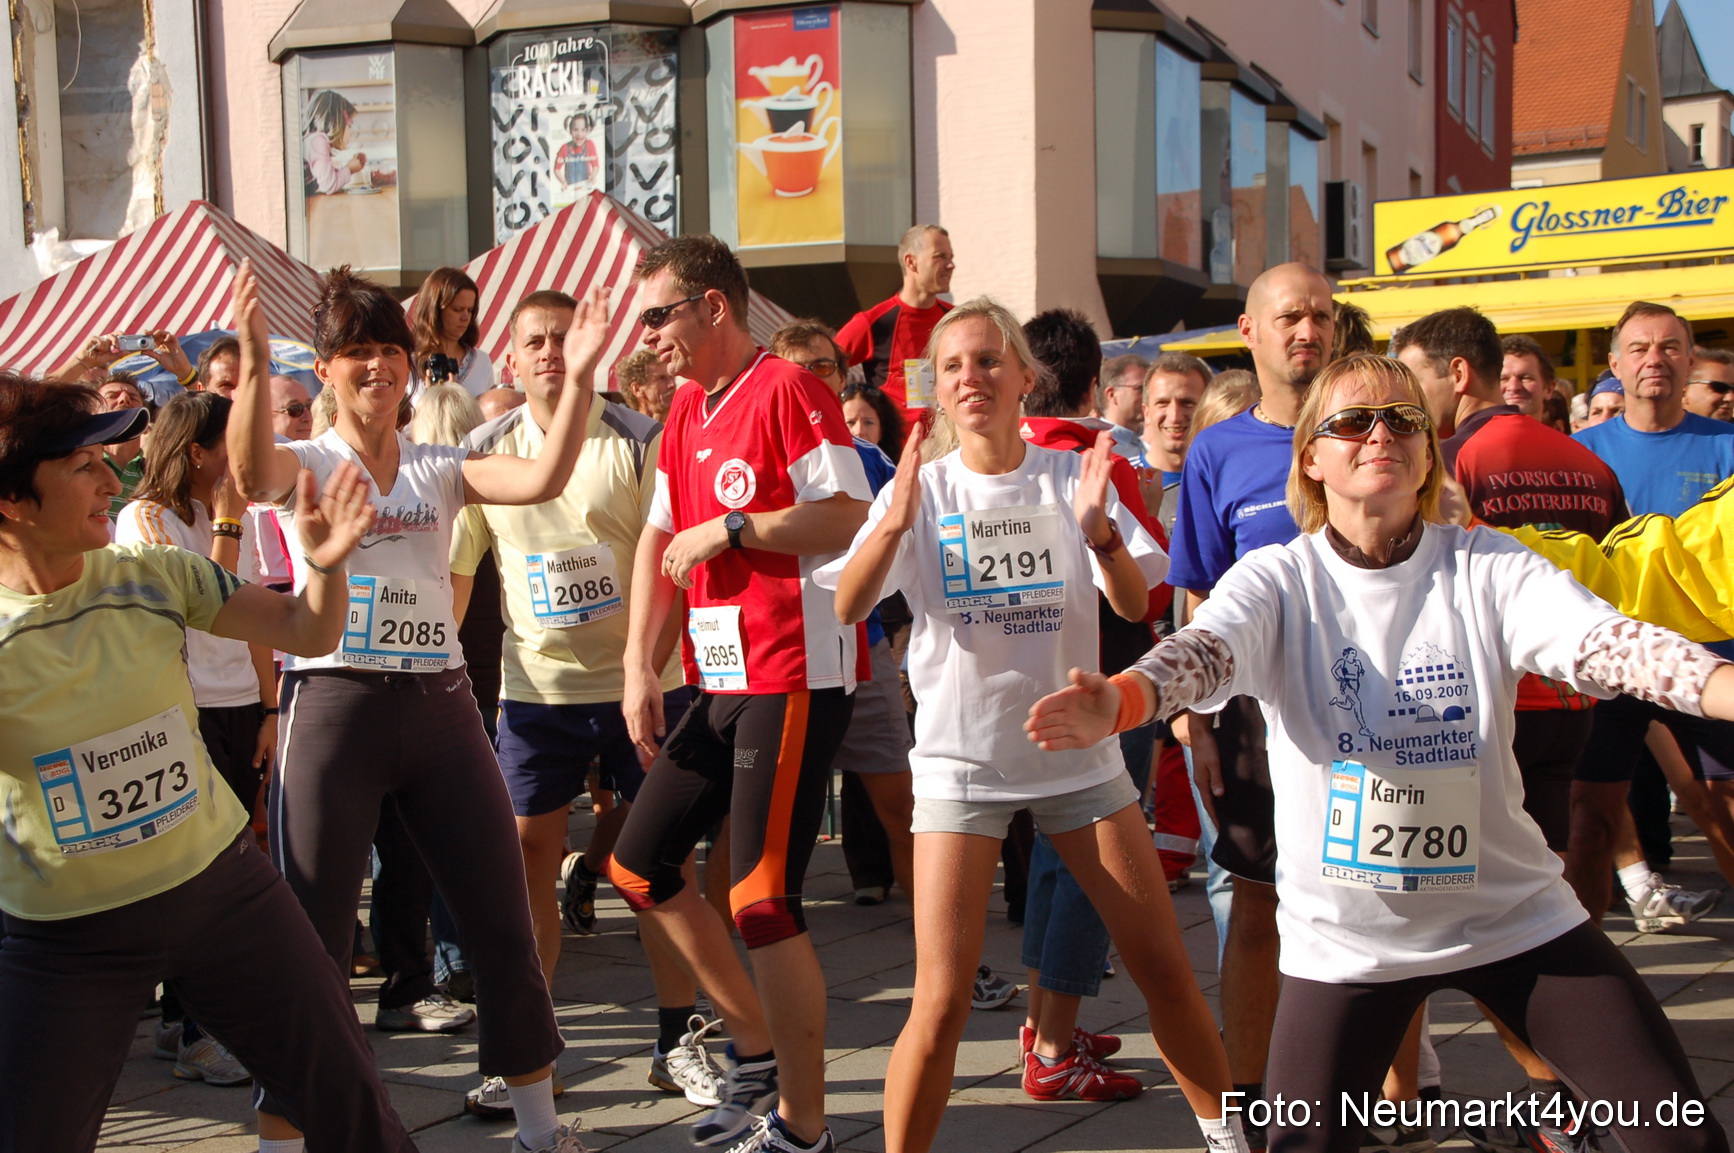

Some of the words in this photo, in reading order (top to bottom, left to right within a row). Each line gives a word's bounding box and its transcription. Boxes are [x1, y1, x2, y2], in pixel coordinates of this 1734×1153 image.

[523, 43, 548, 63] 100
[551, 36, 594, 59] Jahre
[517, 60, 584, 99] RACKL
[1509, 186, 1729, 254] Glossner-Bier
[1480, 492, 1608, 517] KLOSTERBIKER
[971, 518, 1032, 539] Martina
[546, 555, 598, 574] Matthias
[945, 552, 954, 567] C
[978, 548, 1053, 583] 2191
[379, 585, 418, 605] Anita
[554, 575, 614, 607] 2086
[1021, 587, 1064, 600] PFLEIDERER
[946, 595, 993, 609] BOCK
[350, 610, 359, 624] D
[984, 606, 1064, 624] Neumarkter
[378, 619, 447, 648] 2085
[342, 653, 388, 666] BOCK
[412, 658, 448, 667] PFLEIDERER
[703, 644, 739, 667] 2695
[1394, 684, 1469, 704] 16.09.2007
[80, 730, 169, 774] Veronika
[1337, 731, 1363, 754] 8.
[1369, 729, 1474, 752] Neumarkter
[1395, 743, 1477, 766] Stadtlauf
[97, 760, 190, 821] 3273
[1370, 778, 1425, 805] Karin
[53, 796, 66, 813] D
[155, 795, 199, 828] PFLEIDERER
[1332, 808, 1342, 826] D
[61, 833, 122, 853] BOCK
[1369, 823, 1468, 860] 2780
[1322, 865, 1382, 885] BOCK
[1419, 873, 1475, 886] PFLEIDERER
